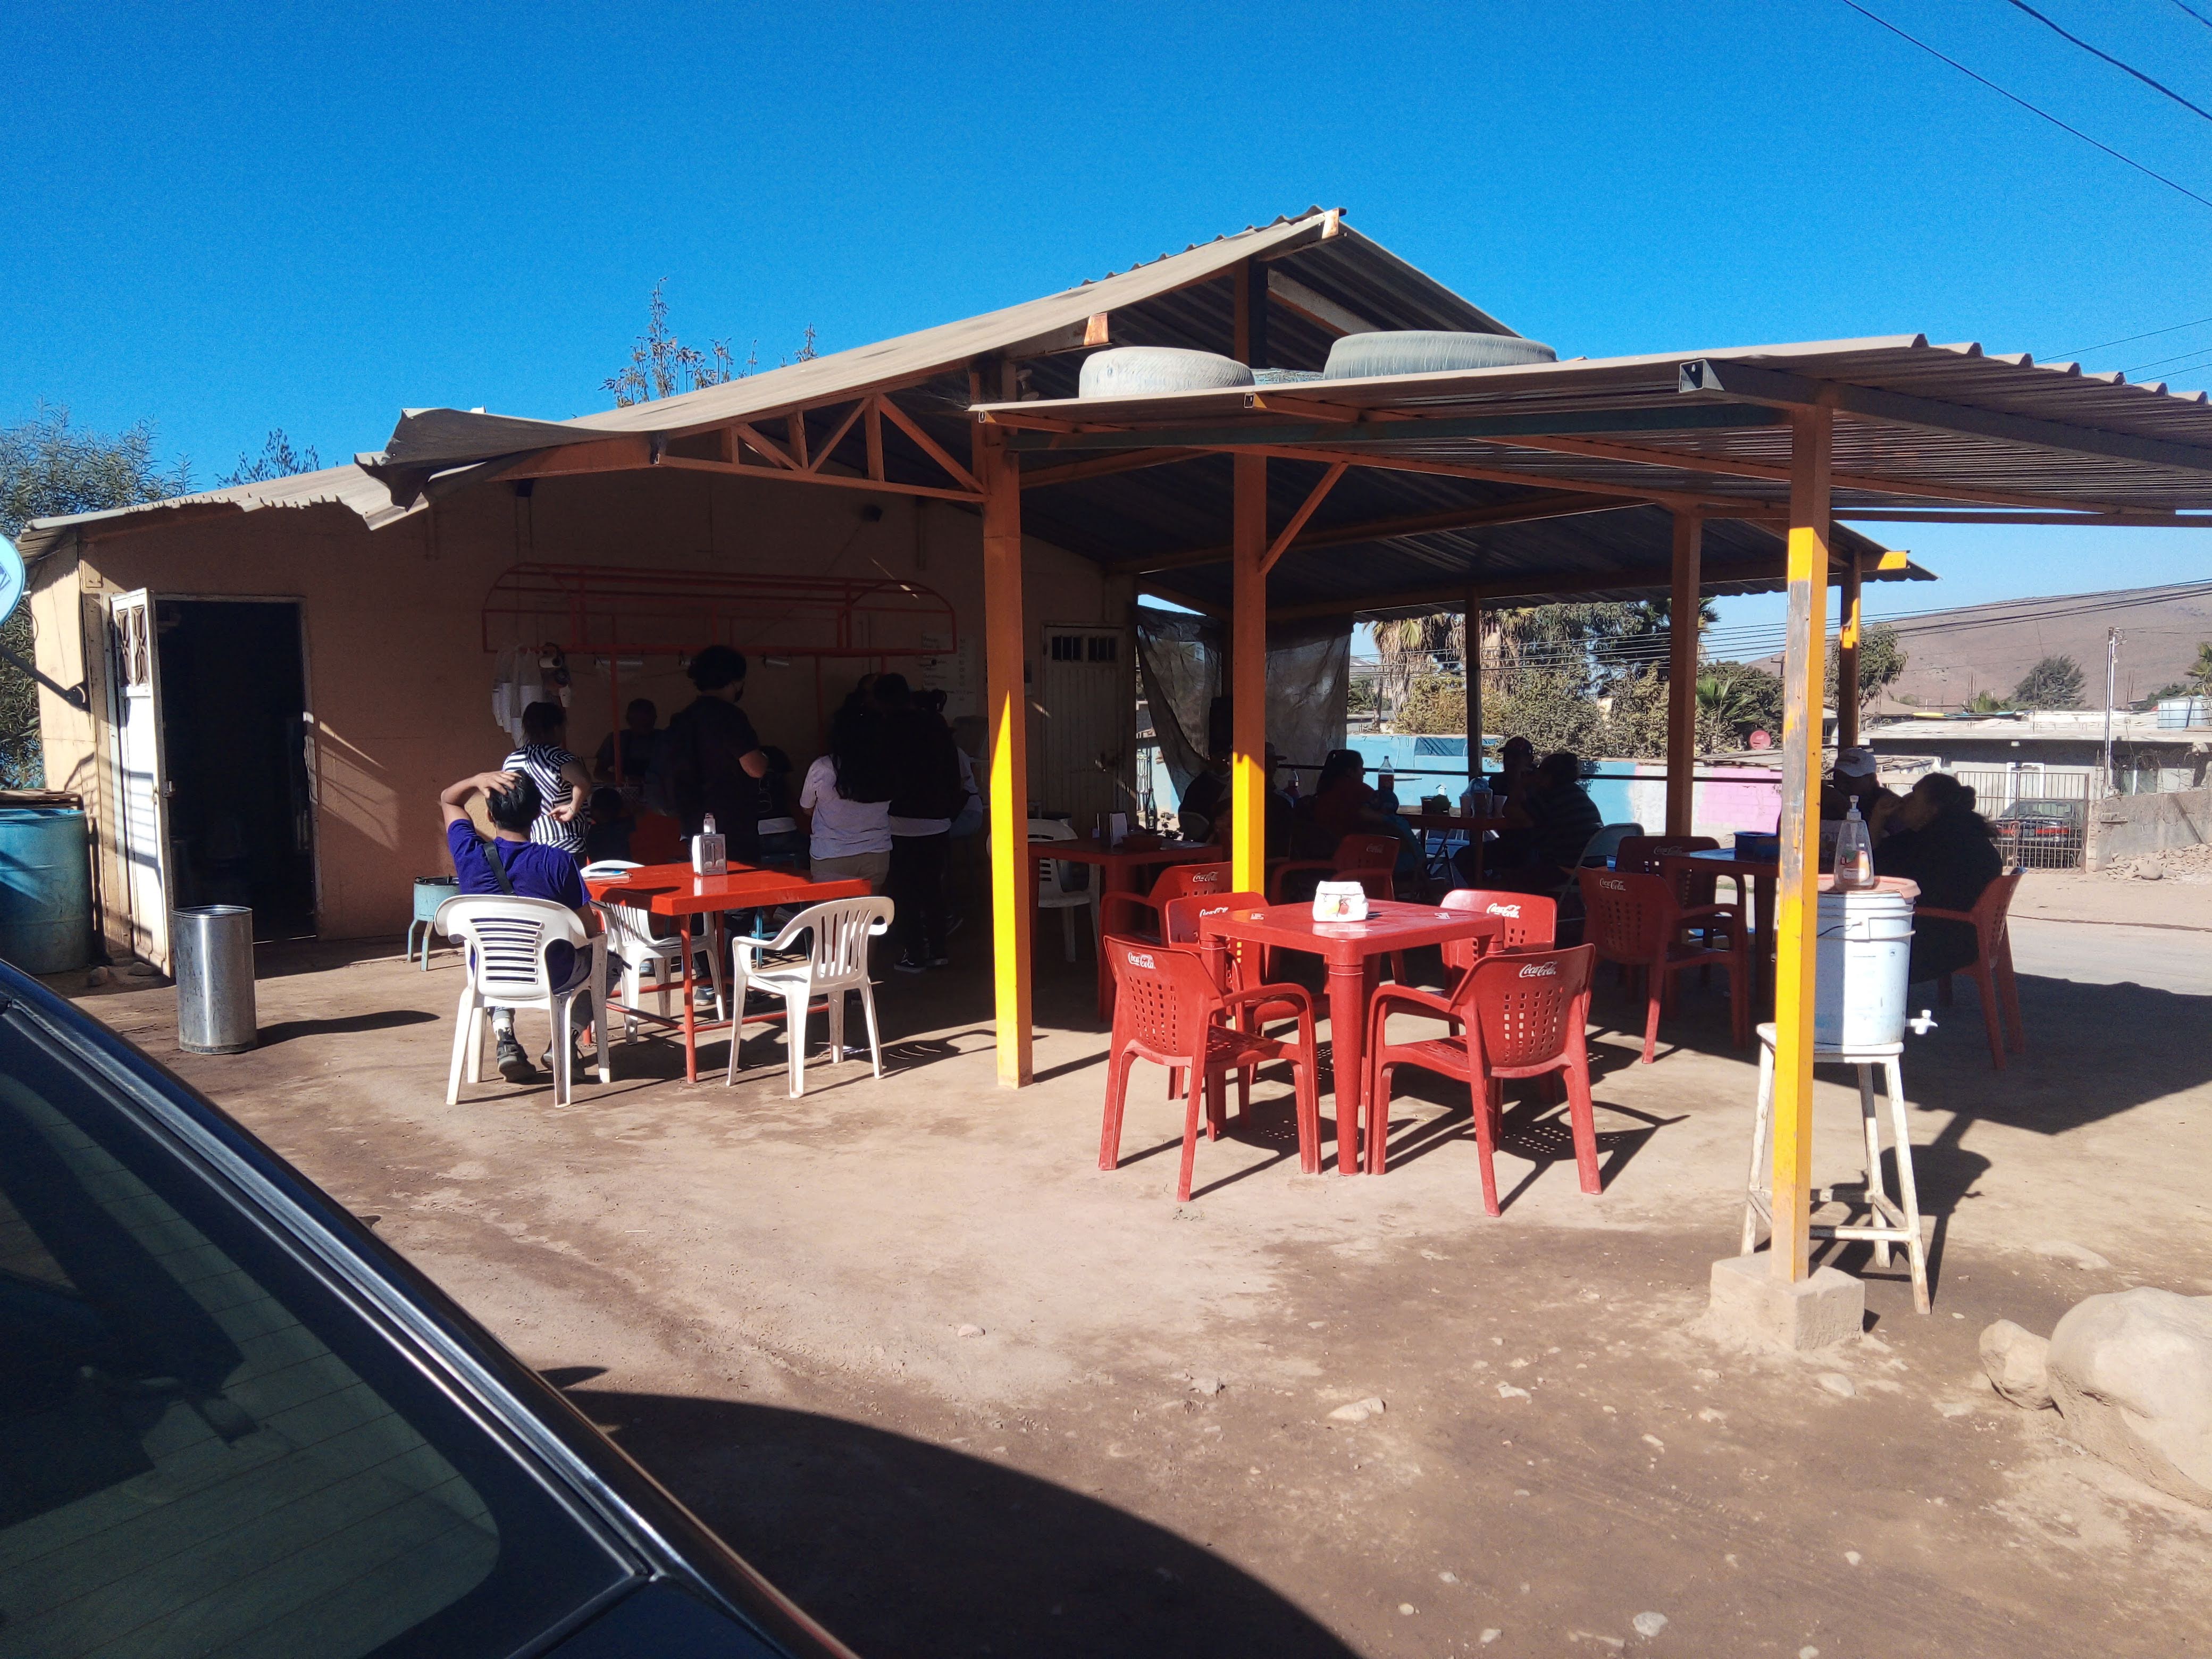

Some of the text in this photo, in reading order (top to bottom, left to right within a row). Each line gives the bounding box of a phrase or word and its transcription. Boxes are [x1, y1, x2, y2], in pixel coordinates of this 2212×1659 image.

[1600, 878, 1626, 891] Coca-Cola
[1128, 952, 1156, 969] Coca-Cola
[1519, 961, 1557, 978] Coca-Cola
